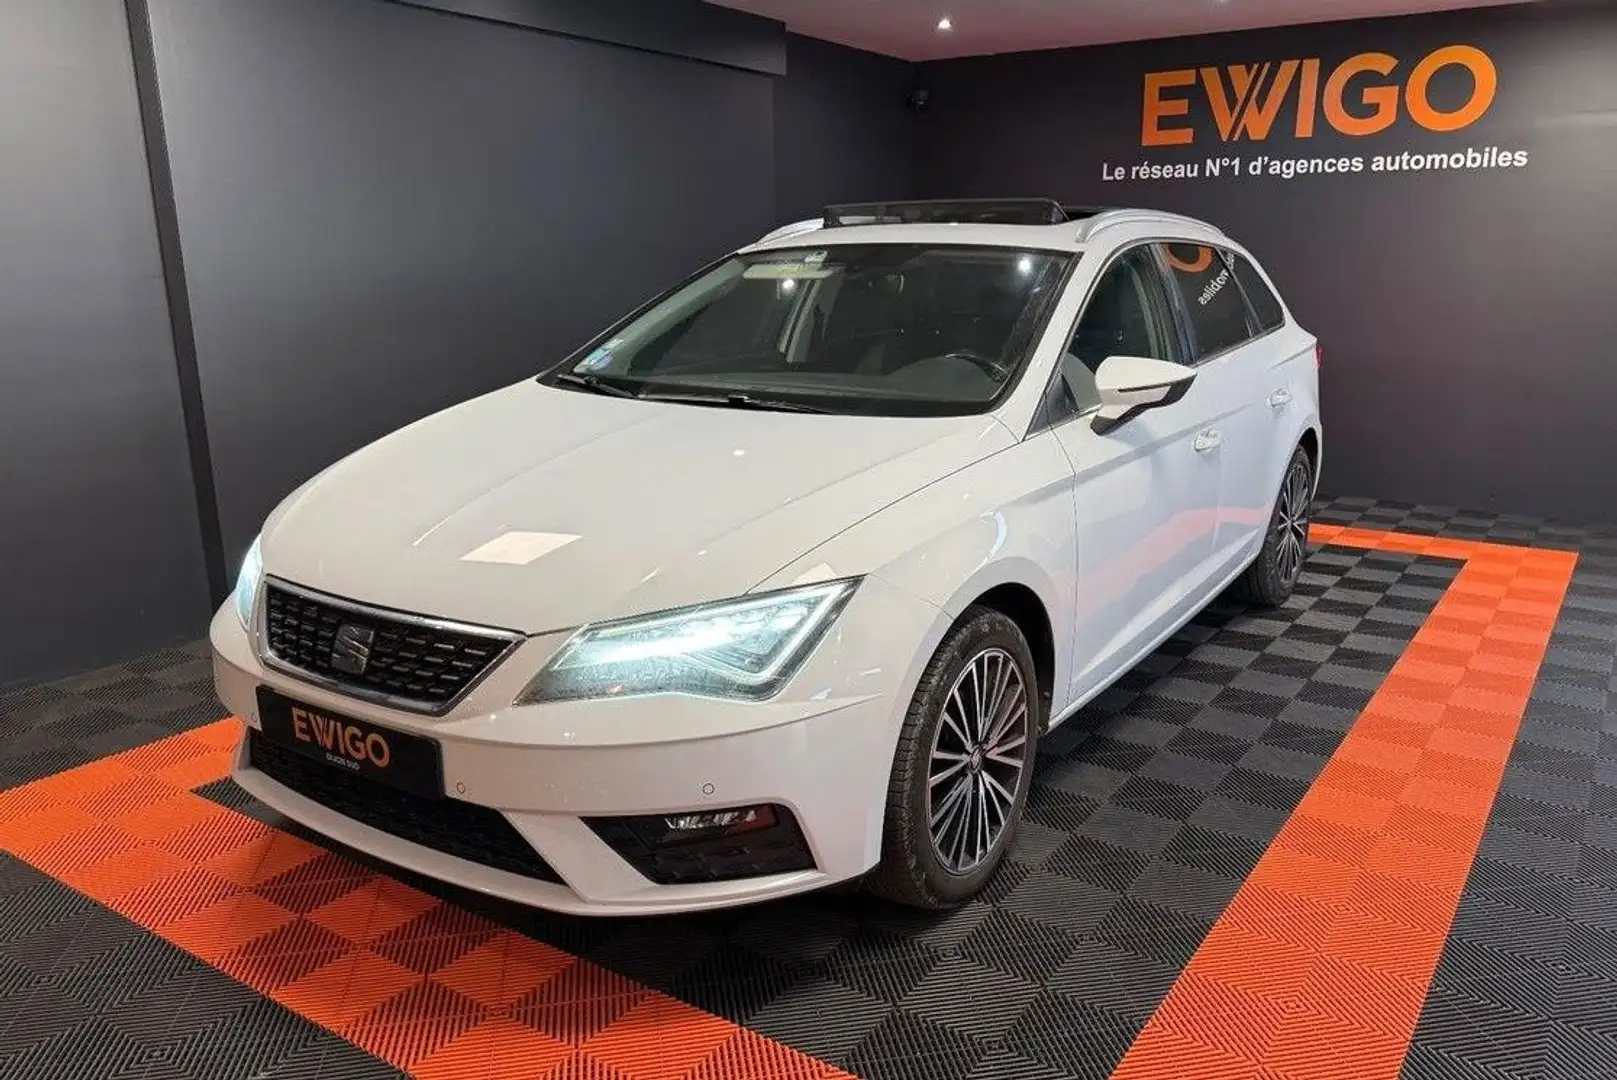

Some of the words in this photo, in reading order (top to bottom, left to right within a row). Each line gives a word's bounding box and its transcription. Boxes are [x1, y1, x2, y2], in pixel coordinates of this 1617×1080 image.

[1142, 45, 1497, 146] EWIGO
[1102, 163, 1126, 181] Le
[1131, 160, 1198, 180] réseau
[1205, 157, 1240, 177] N°1
[1249, 156, 1364, 179] d'agences
[1371, 147, 1529, 172] automobiles
[292, 707, 390, 768] EWIGO
